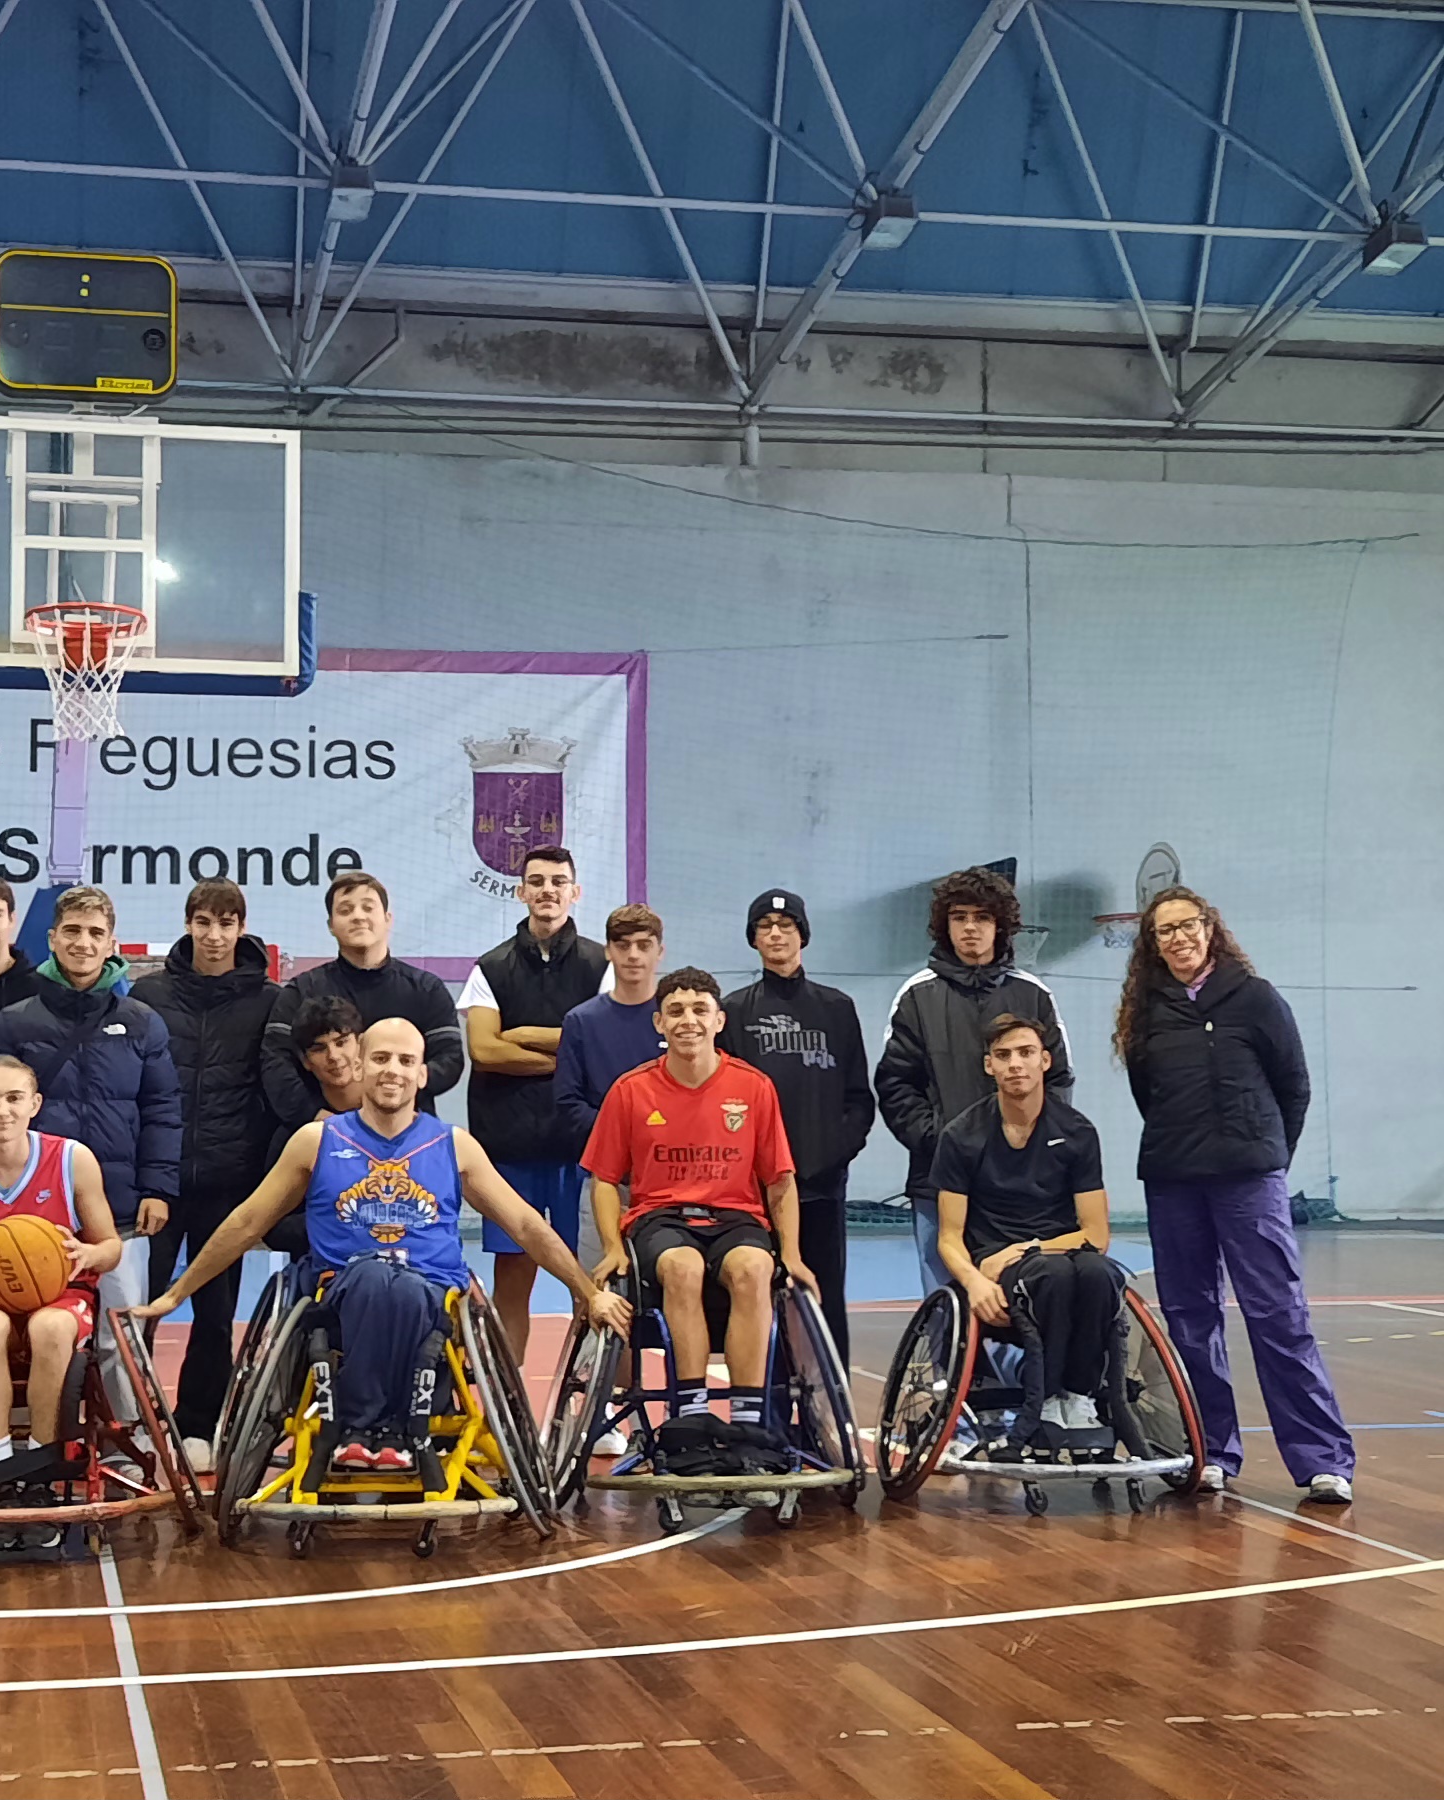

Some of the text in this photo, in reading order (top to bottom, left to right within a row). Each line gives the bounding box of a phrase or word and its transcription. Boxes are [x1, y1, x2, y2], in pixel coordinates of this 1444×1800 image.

[29, 717, 397, 792] Feguesias
[469, 870, 516, 899] SERM
[759, 1030, 826, 1055] PUMA
[654, 1143, 744, 1163] Emirates
